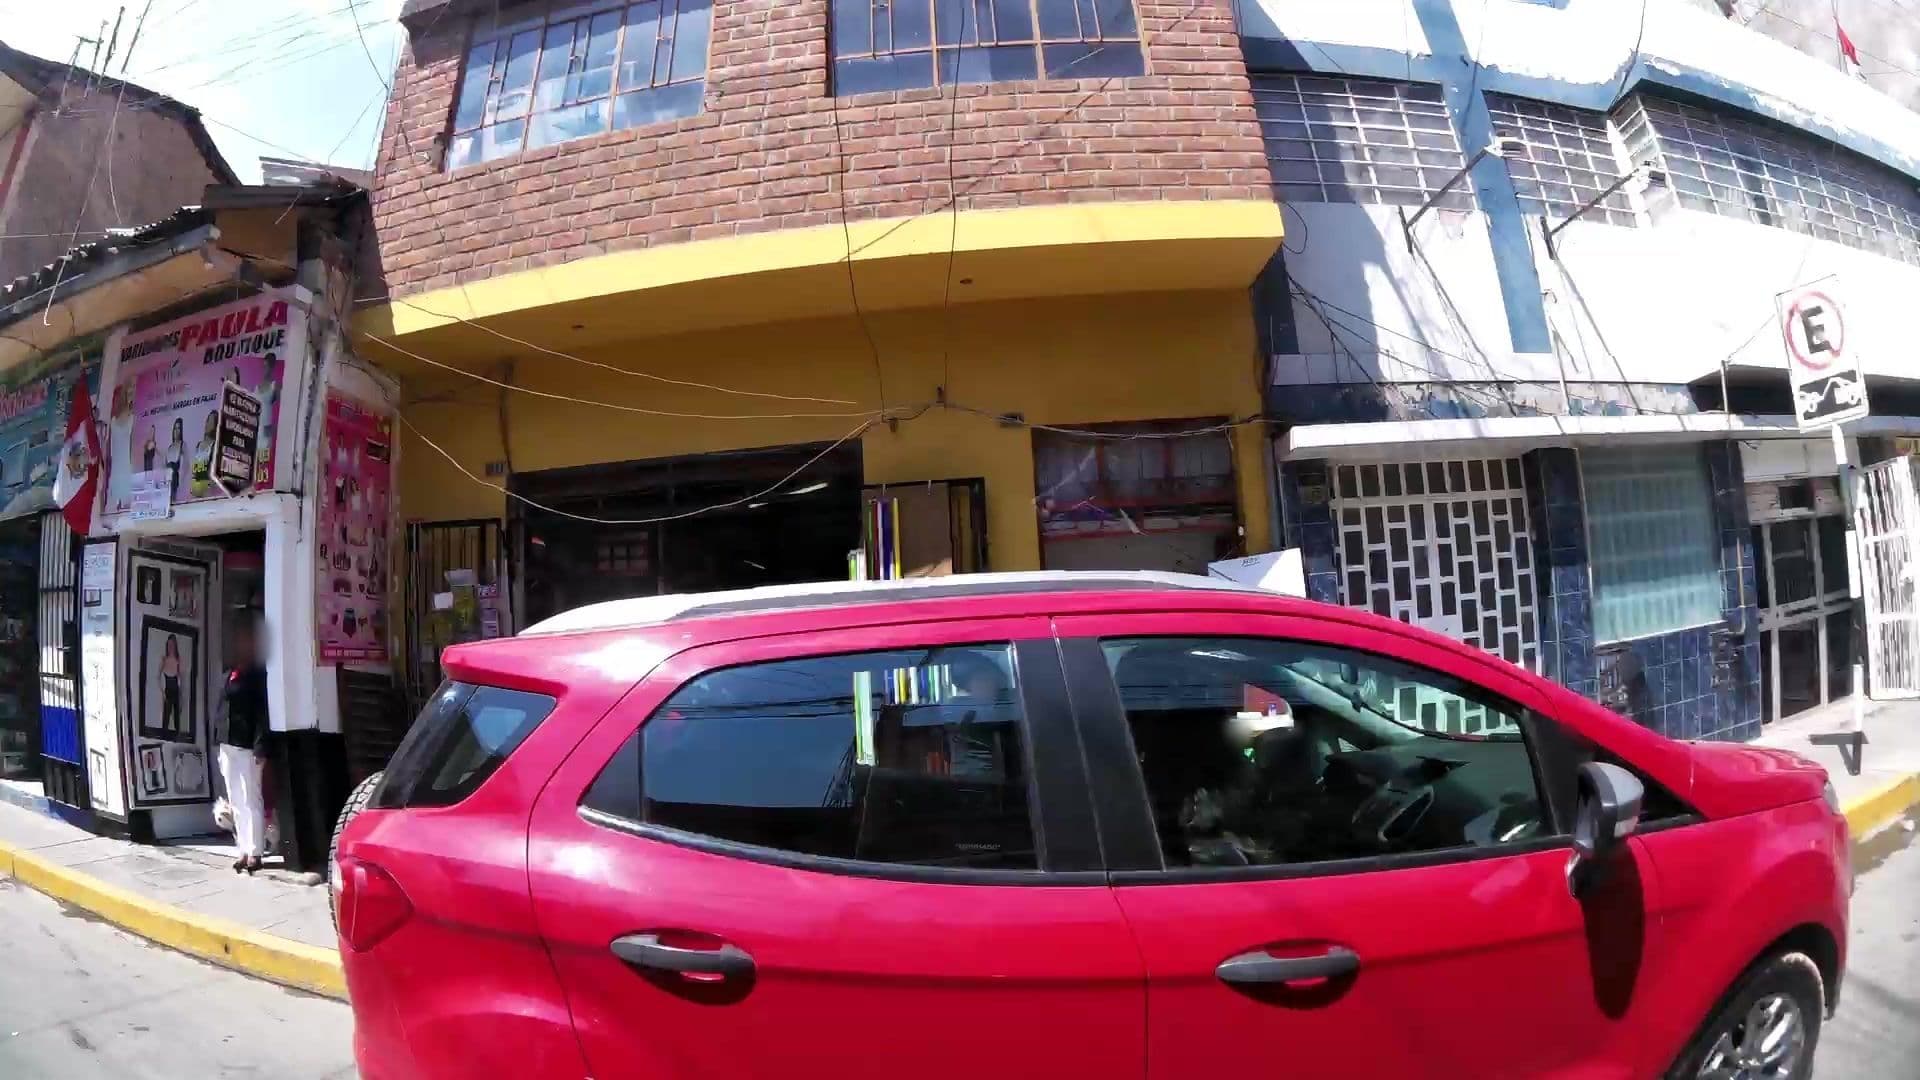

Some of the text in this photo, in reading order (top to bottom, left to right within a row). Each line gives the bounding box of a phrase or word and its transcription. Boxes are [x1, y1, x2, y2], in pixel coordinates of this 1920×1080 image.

[178, 301, 288, 352] PAULA
[203, 329, 285, 365] BOUTIQUE
[1800, 305, 1833, 354] E
